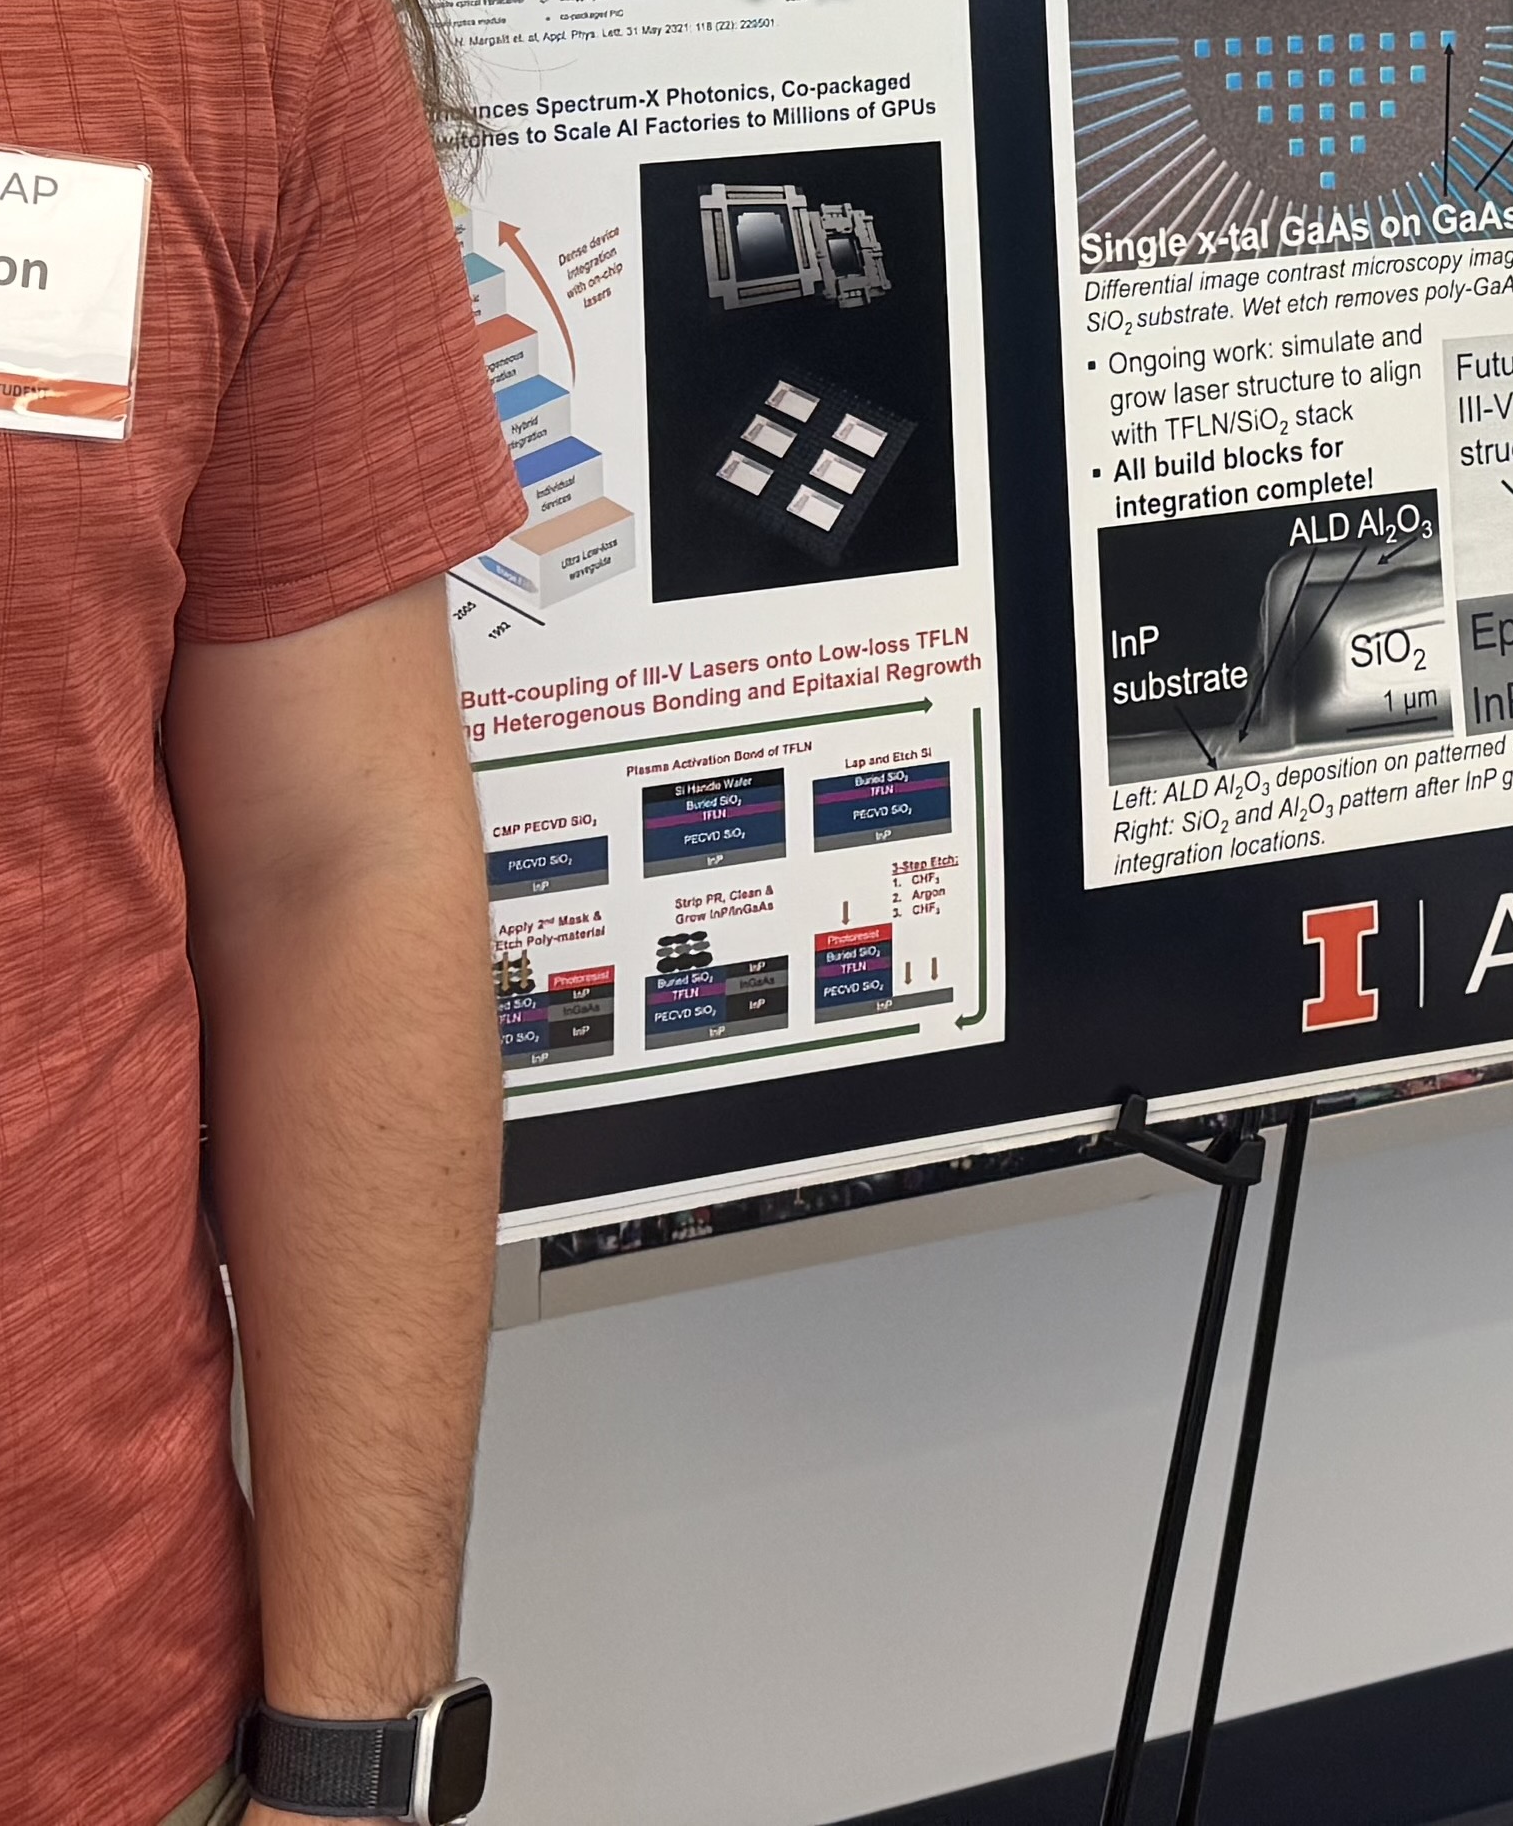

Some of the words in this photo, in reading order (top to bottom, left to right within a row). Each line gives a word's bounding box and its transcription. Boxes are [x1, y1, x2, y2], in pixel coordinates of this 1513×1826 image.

[1080, 228, 1188, 270] Single
[1196, 223, 1271, 255] x-tal
[1280, 219, 1371, 250] GaAs
[1380, 211, 1422, 239] on
[1108, 345, 1206, 378] Ongoing
[1212, 337, 1274, 365] work:
[1281, 329, 1375, 358] simulate
[1382, 321, 1422, 349] and
[459, 674, 609, 713] Butt-coupling
[615, 668, 638, 690] of
[643, 662, 683, 687] III-V
[690, 657, 760, 681] Lasers
[766, 647, 813, 670] onto
[819, 637, 910, 663] Low-loss
[915, 625, 969, 650] TFLN
[767, 744, 780, 758] of
[782, 740, 813, 756] TFLN
